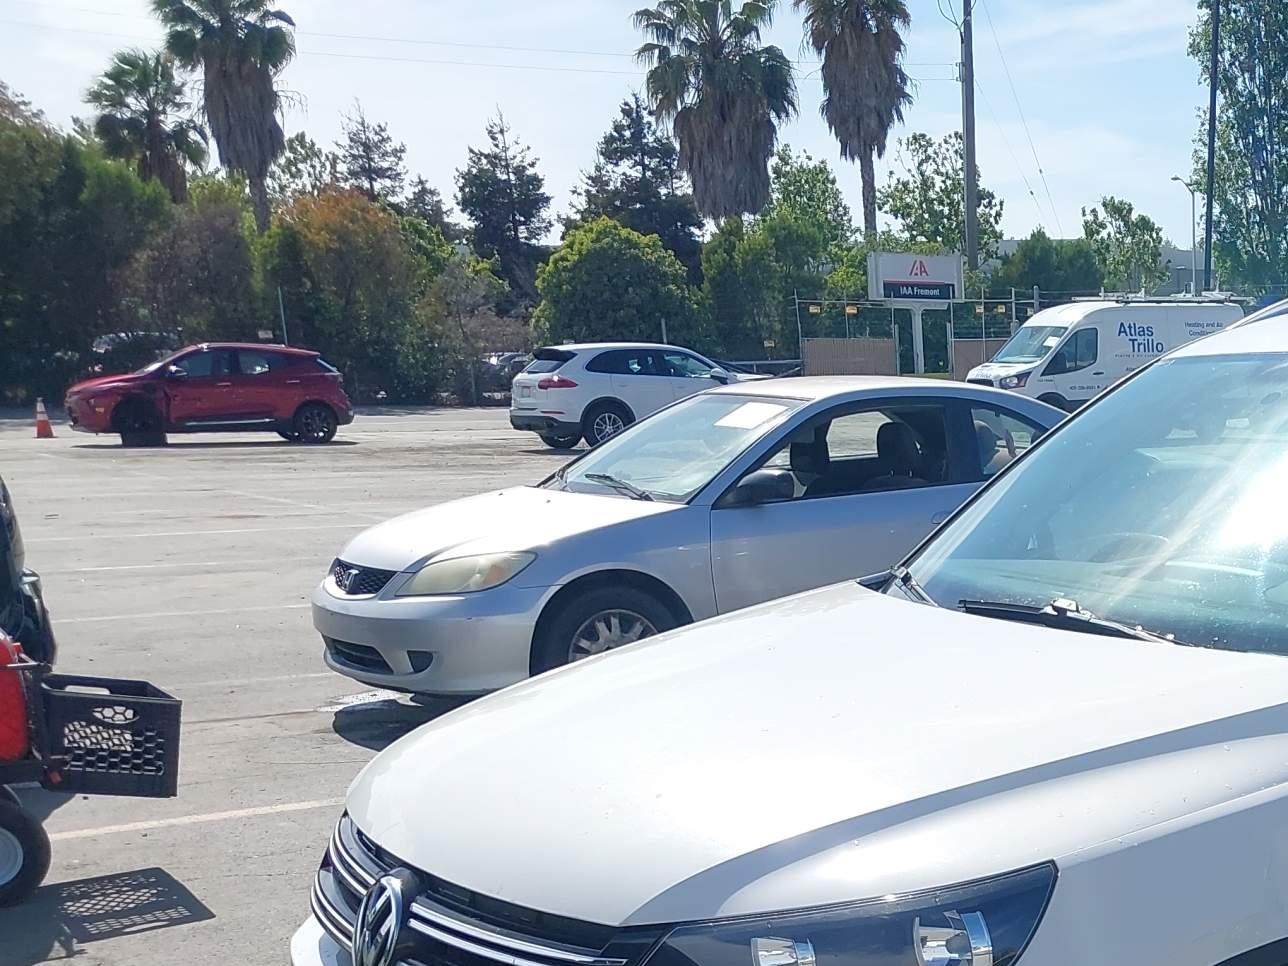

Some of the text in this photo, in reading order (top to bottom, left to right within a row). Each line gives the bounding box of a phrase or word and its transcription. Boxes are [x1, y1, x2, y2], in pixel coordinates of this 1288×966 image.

[900, 286, 940, 296] IAA Fremont
[1118, 322, 1154, 337] Atlas
[1129, 338, 1164, 353] Trillo
